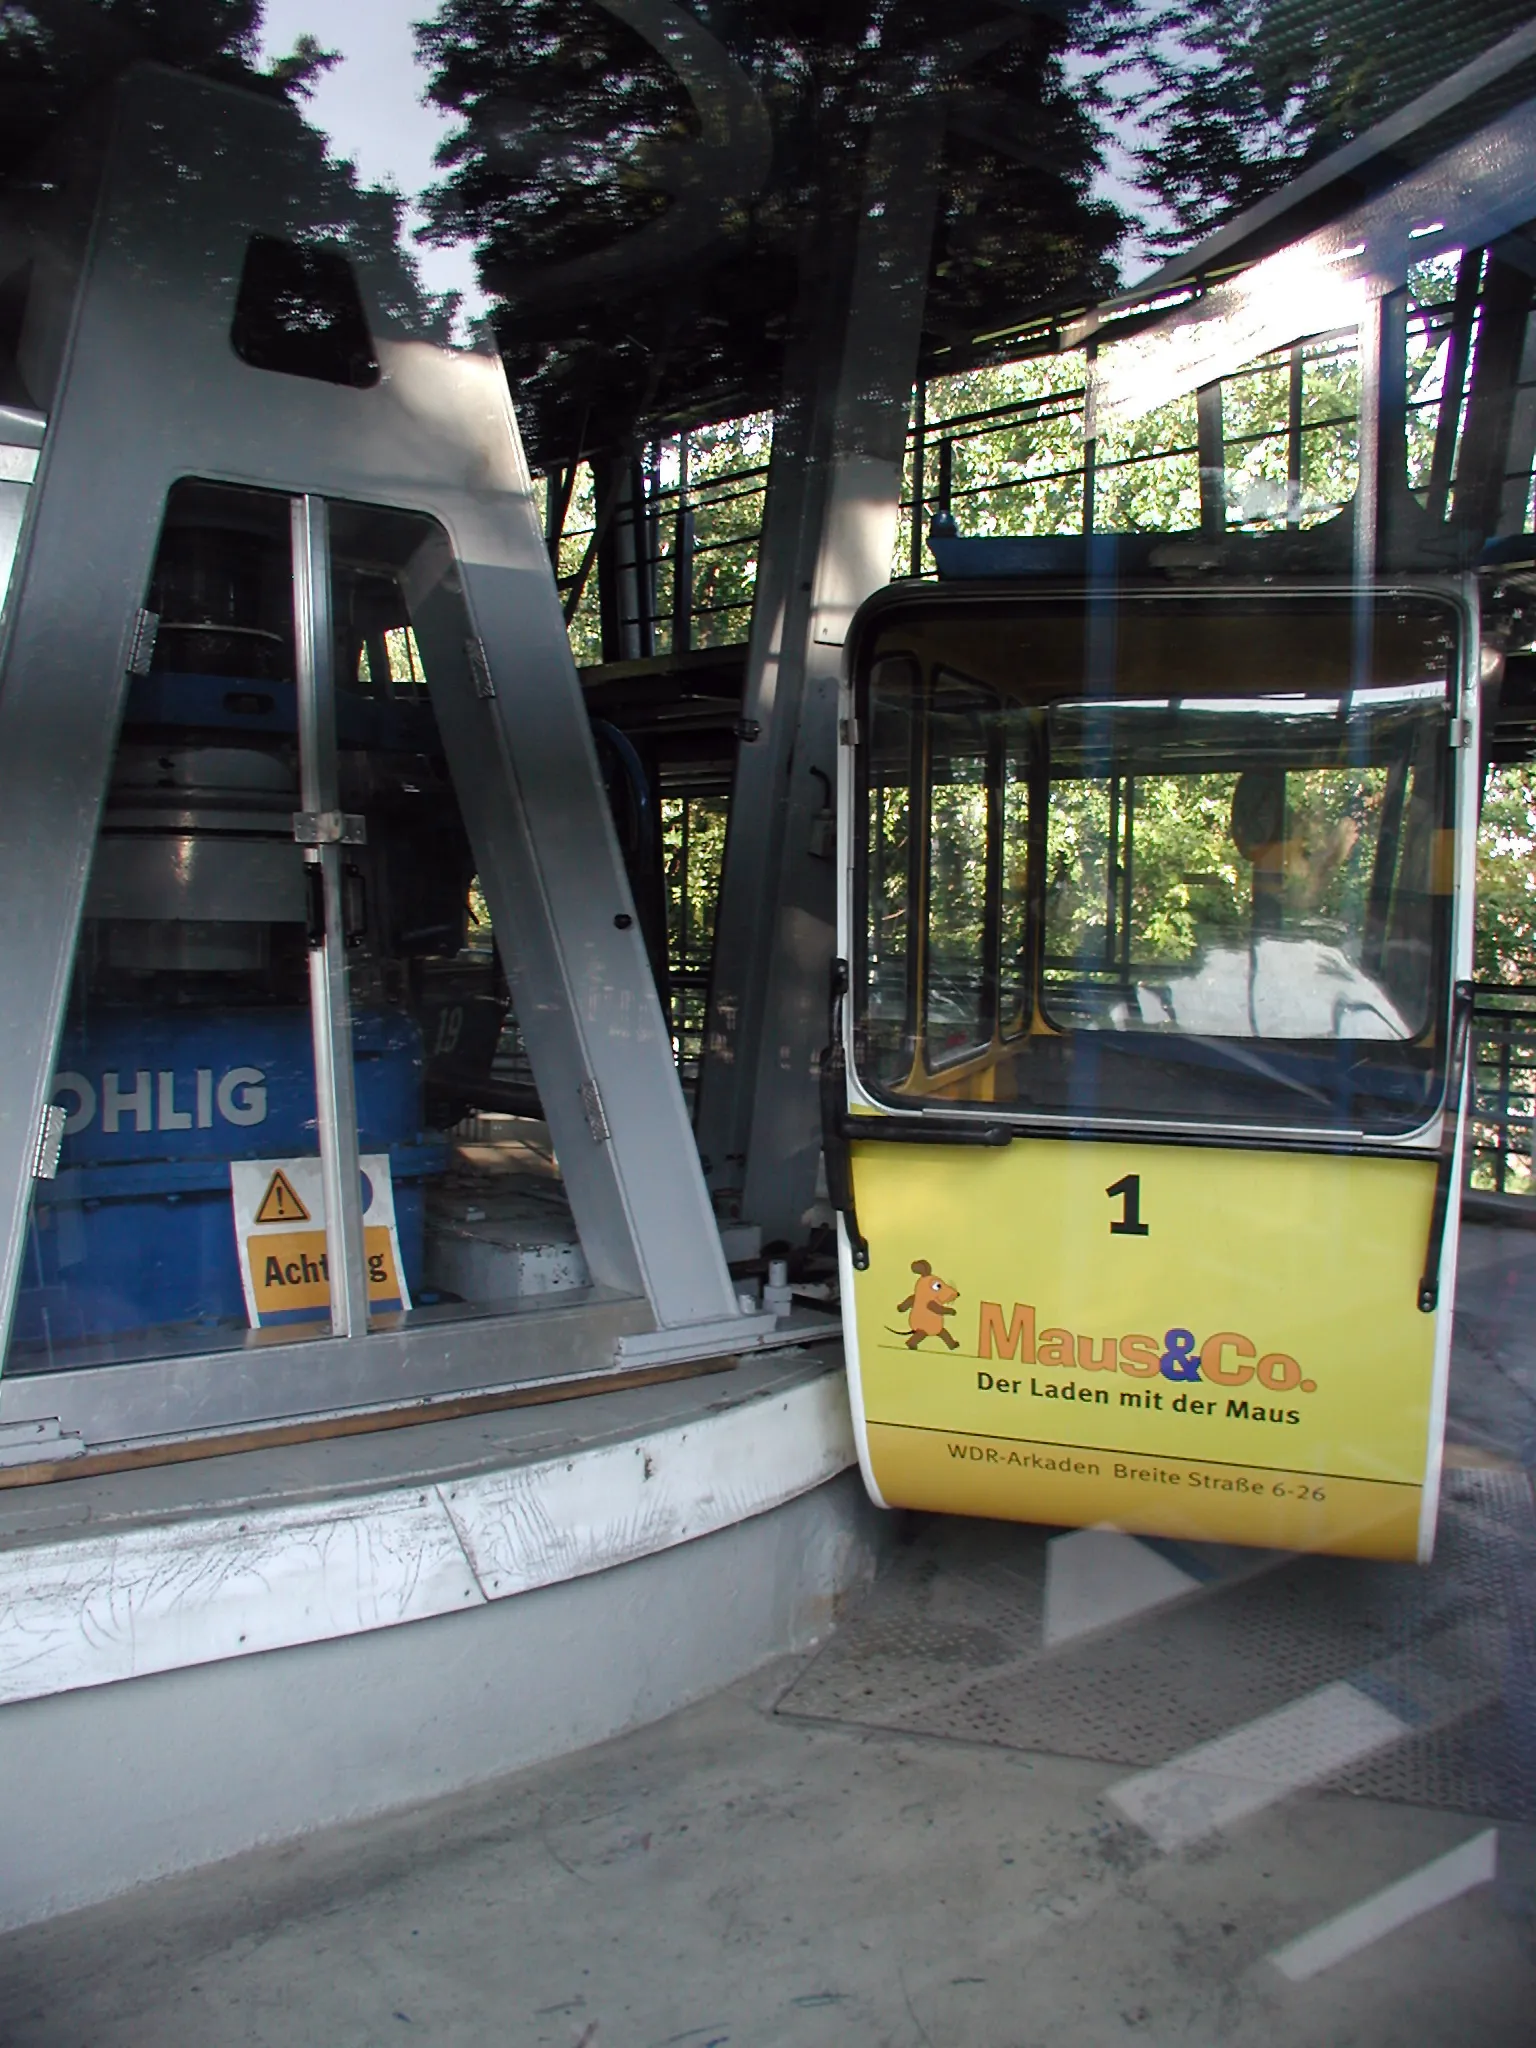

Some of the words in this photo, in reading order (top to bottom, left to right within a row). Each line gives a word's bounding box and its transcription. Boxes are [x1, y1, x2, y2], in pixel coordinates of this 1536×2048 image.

[1105, 1174, 1149, 1236] 1
[265, 1252, 387, 1287] Achtg
[978, 1300, 1318, 1394] Maus&Co.
[977, 1371, 1021, 1395] Der
[1030, 1378, 1109, 1404] Laden
[1119, 1391, 1163, 1411] mit
[1172, 1394, 1217, 1416] der
[1225, 1399, 1301, 1425] Maus
[947, 1443, 1100, 1476] WDR-Arkaden
[1113, 1463, 1181, 1486] Breite
[1187, 1471, 1265, 1496] Straße
[1271, 1482, 1326, 1502] 6-26
